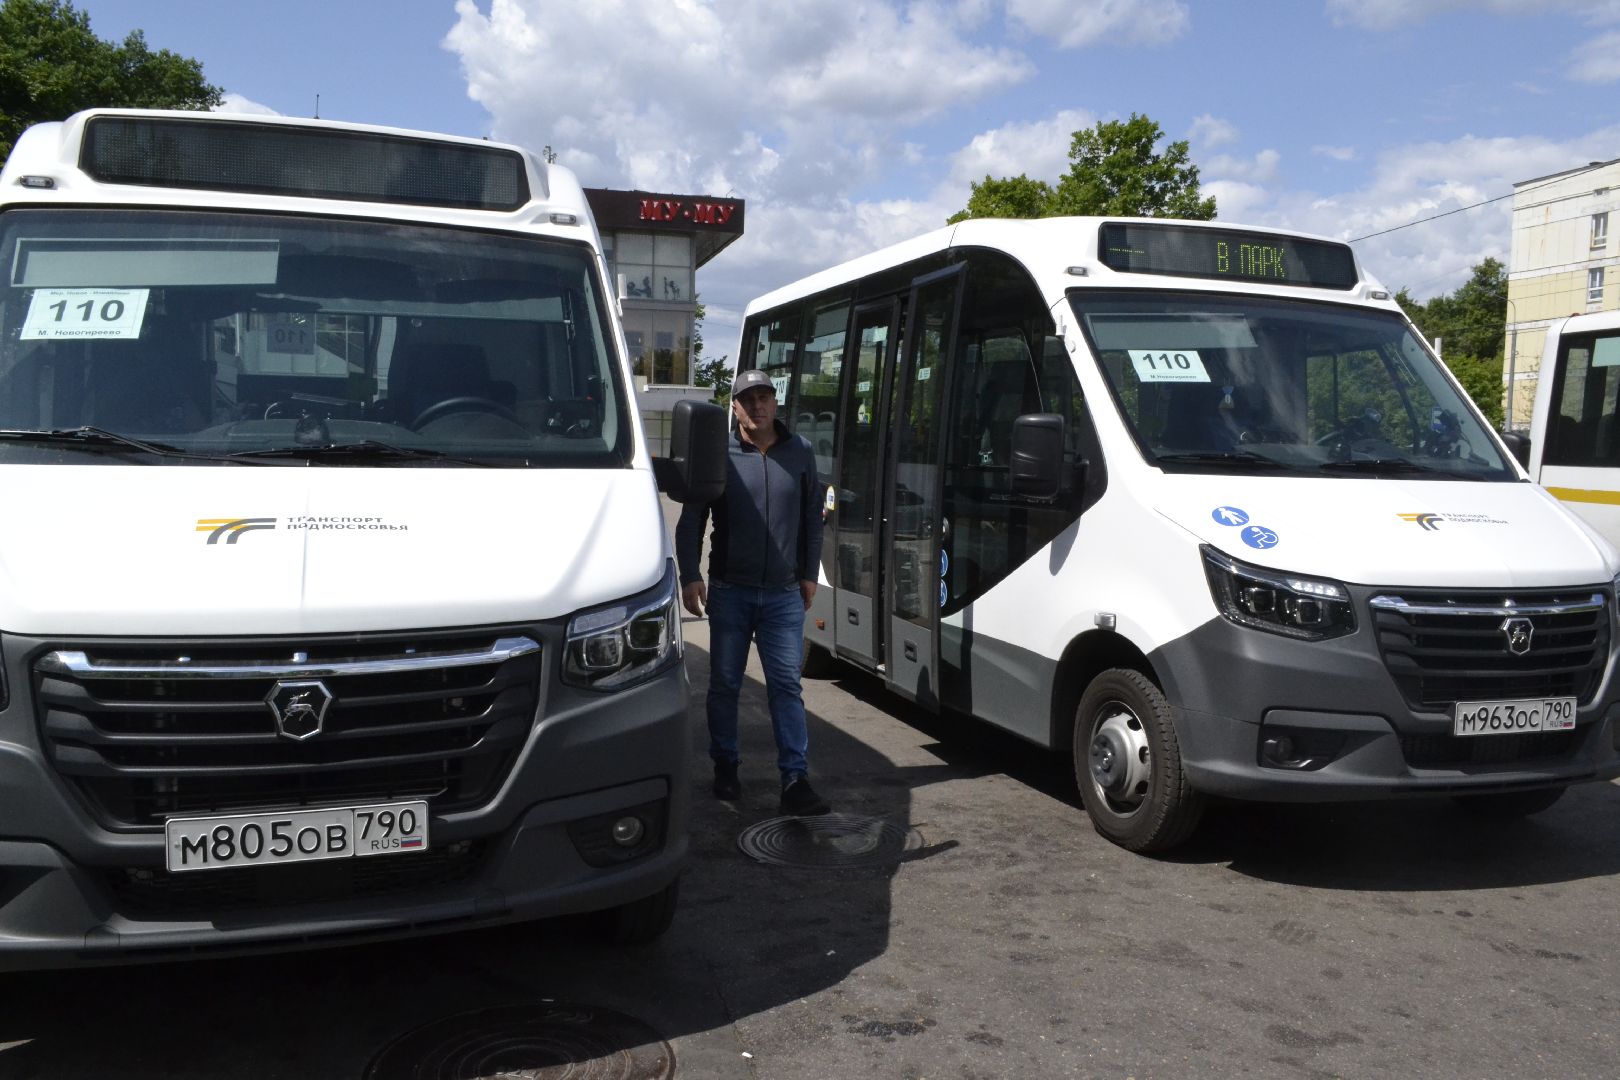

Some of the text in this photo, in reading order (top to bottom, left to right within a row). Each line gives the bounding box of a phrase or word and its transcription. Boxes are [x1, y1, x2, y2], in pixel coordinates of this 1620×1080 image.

[1217, 241, 1286, 279] В ПАРК
[49, 299, 125, 322] 110
[54, 329, 121, 337] Новогиреево
[1142, 353, 1191, 370] 110
[287, 523, 408, 531] ПОДМОСКОВЬЯ
[1544, 701, 1572, 721] 790
[356, 808, 417, 840] 790
[371, 838, 400, 850] RUS
